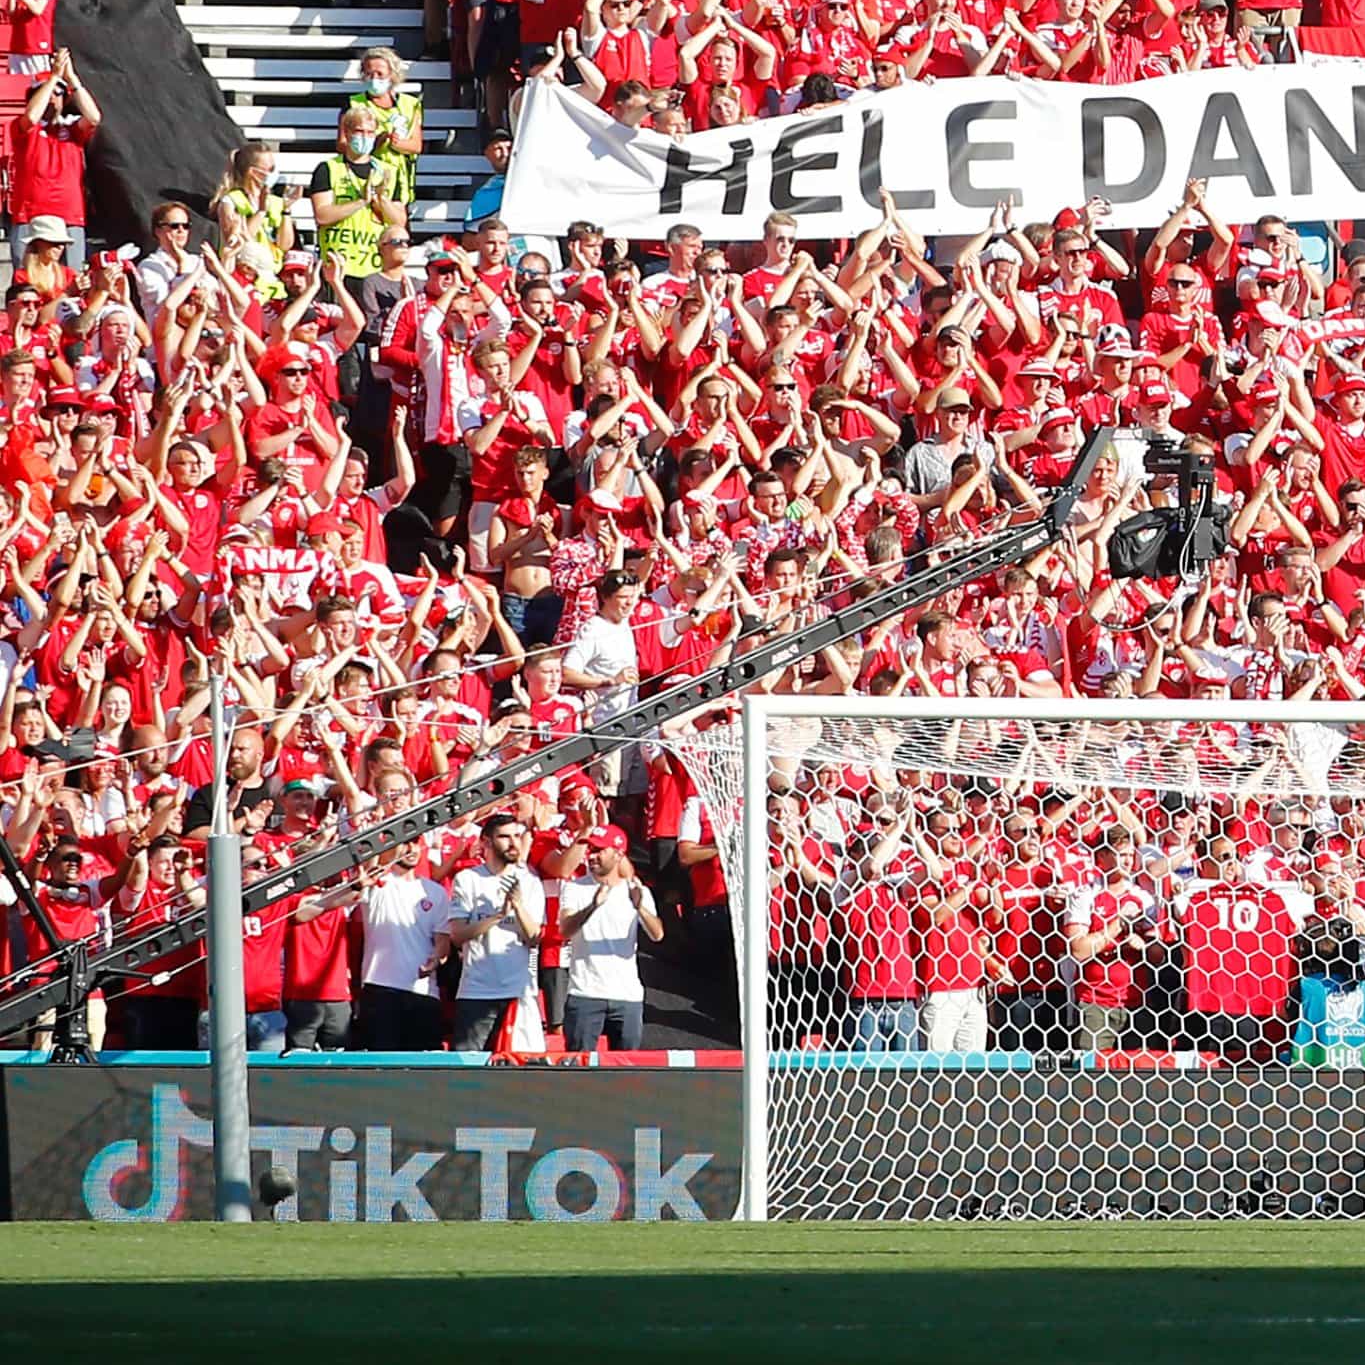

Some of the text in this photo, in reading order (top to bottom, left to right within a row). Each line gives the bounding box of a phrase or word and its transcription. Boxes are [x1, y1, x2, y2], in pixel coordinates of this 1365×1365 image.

[661, 99, 1024, 216] HELE
[325, 227, 380, 247] STEWA
[1213, 897, 1259, 932] 10
[248, 1127, 714, 1222] TikTok
